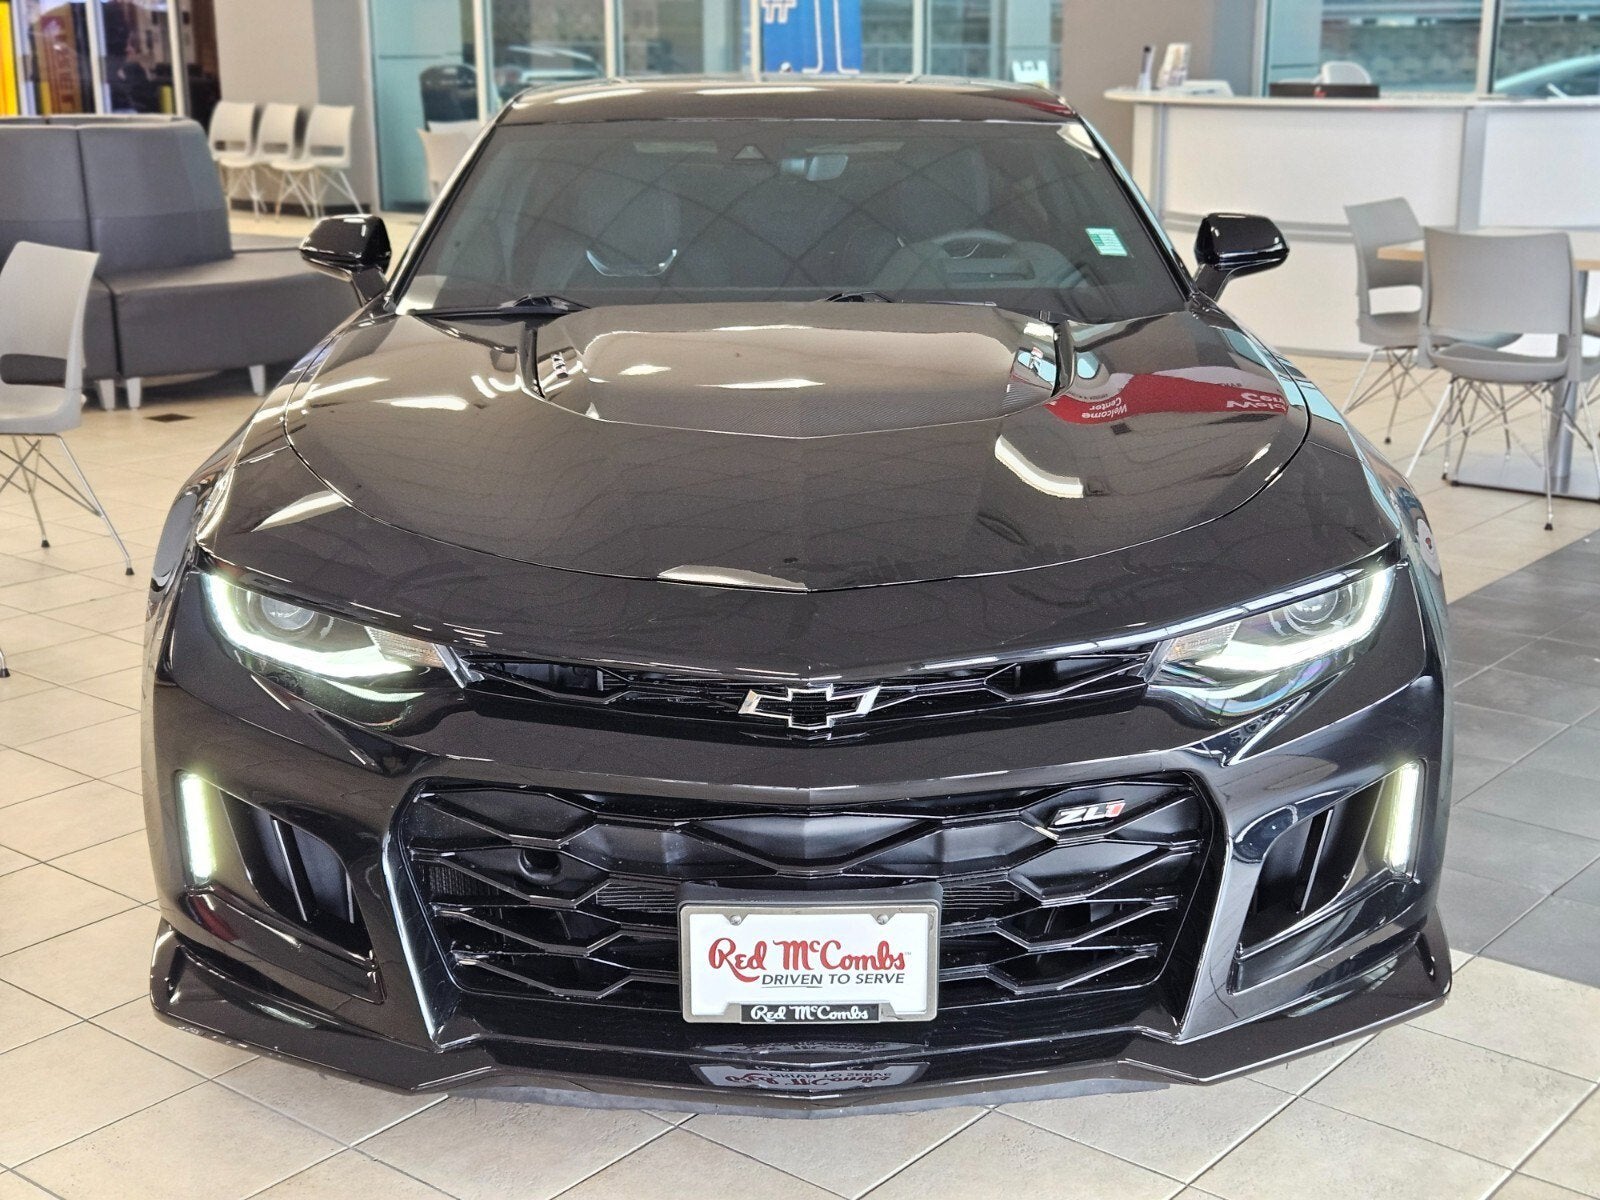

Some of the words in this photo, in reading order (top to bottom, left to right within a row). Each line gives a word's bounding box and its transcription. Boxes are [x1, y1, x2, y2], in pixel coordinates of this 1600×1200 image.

[1081, 403, 1128, 419] Welcome
[1089, 397, 1122, 411] Center
[1055, 802, 1126, 826] ZL1
[708, 937, 767, 983] Red
[773, 939, 906, 971] McCombs
[761, 974, 823, 985] DRIVEN
[828, 973, 851, 985] TO
[855, 973, 905, 984] SERVE
[750, 1005, 787, 1023] Red
[789, 1005, 869, 1021] McCombs
